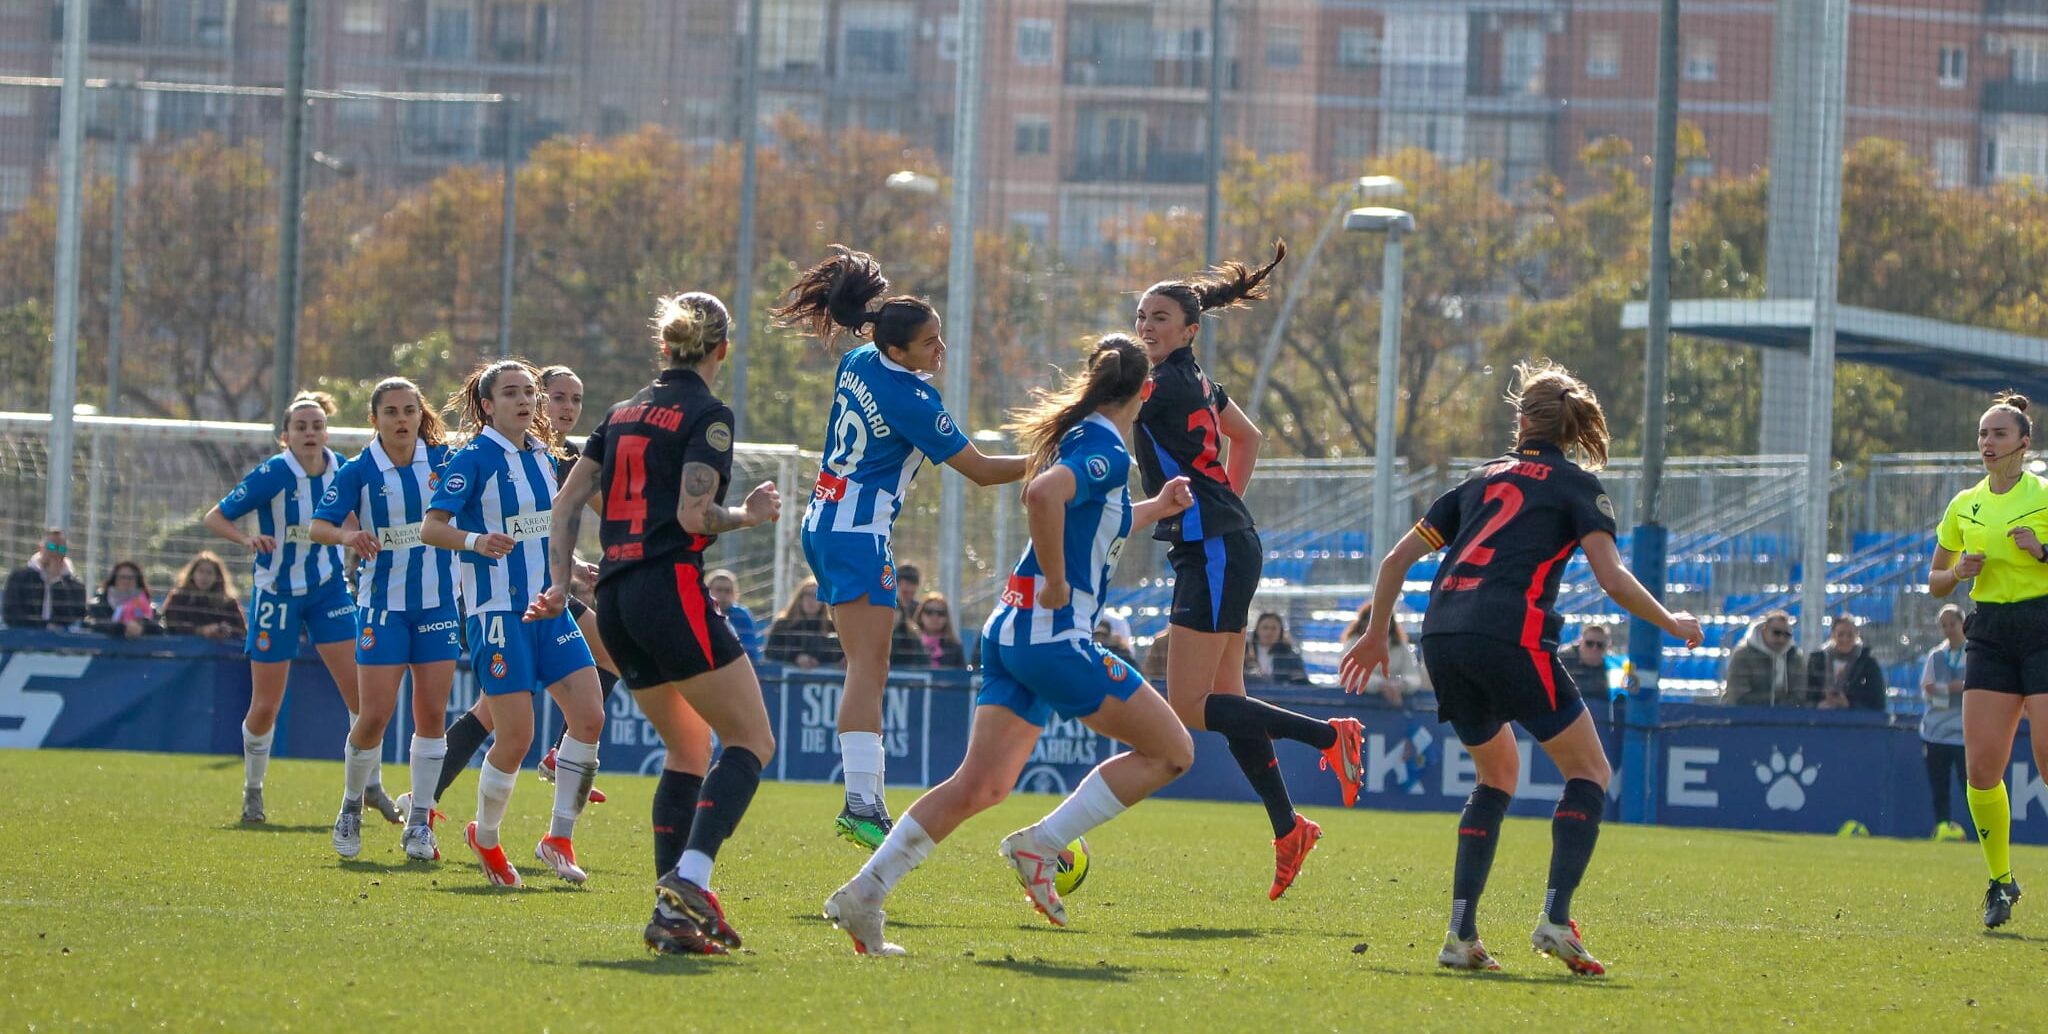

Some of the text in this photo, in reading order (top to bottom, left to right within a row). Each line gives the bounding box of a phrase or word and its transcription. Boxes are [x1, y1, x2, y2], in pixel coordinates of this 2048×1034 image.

[643, 403, 685, 432] LEÓN
[839, 371, 891, 438] CHAMORRO
[1186, 404, 1228, 485] 2
[606, 434, 651, 535] 4
[1455, 481, 1525, 566] 2
[259, 601, 289, 630] 21
[487, 615, 506, 649] 4
[801, 683, 910, 729] SON
[1030, 738, 1098, 765] ABRAS
[1368, 730, 1720, 807] KELE
